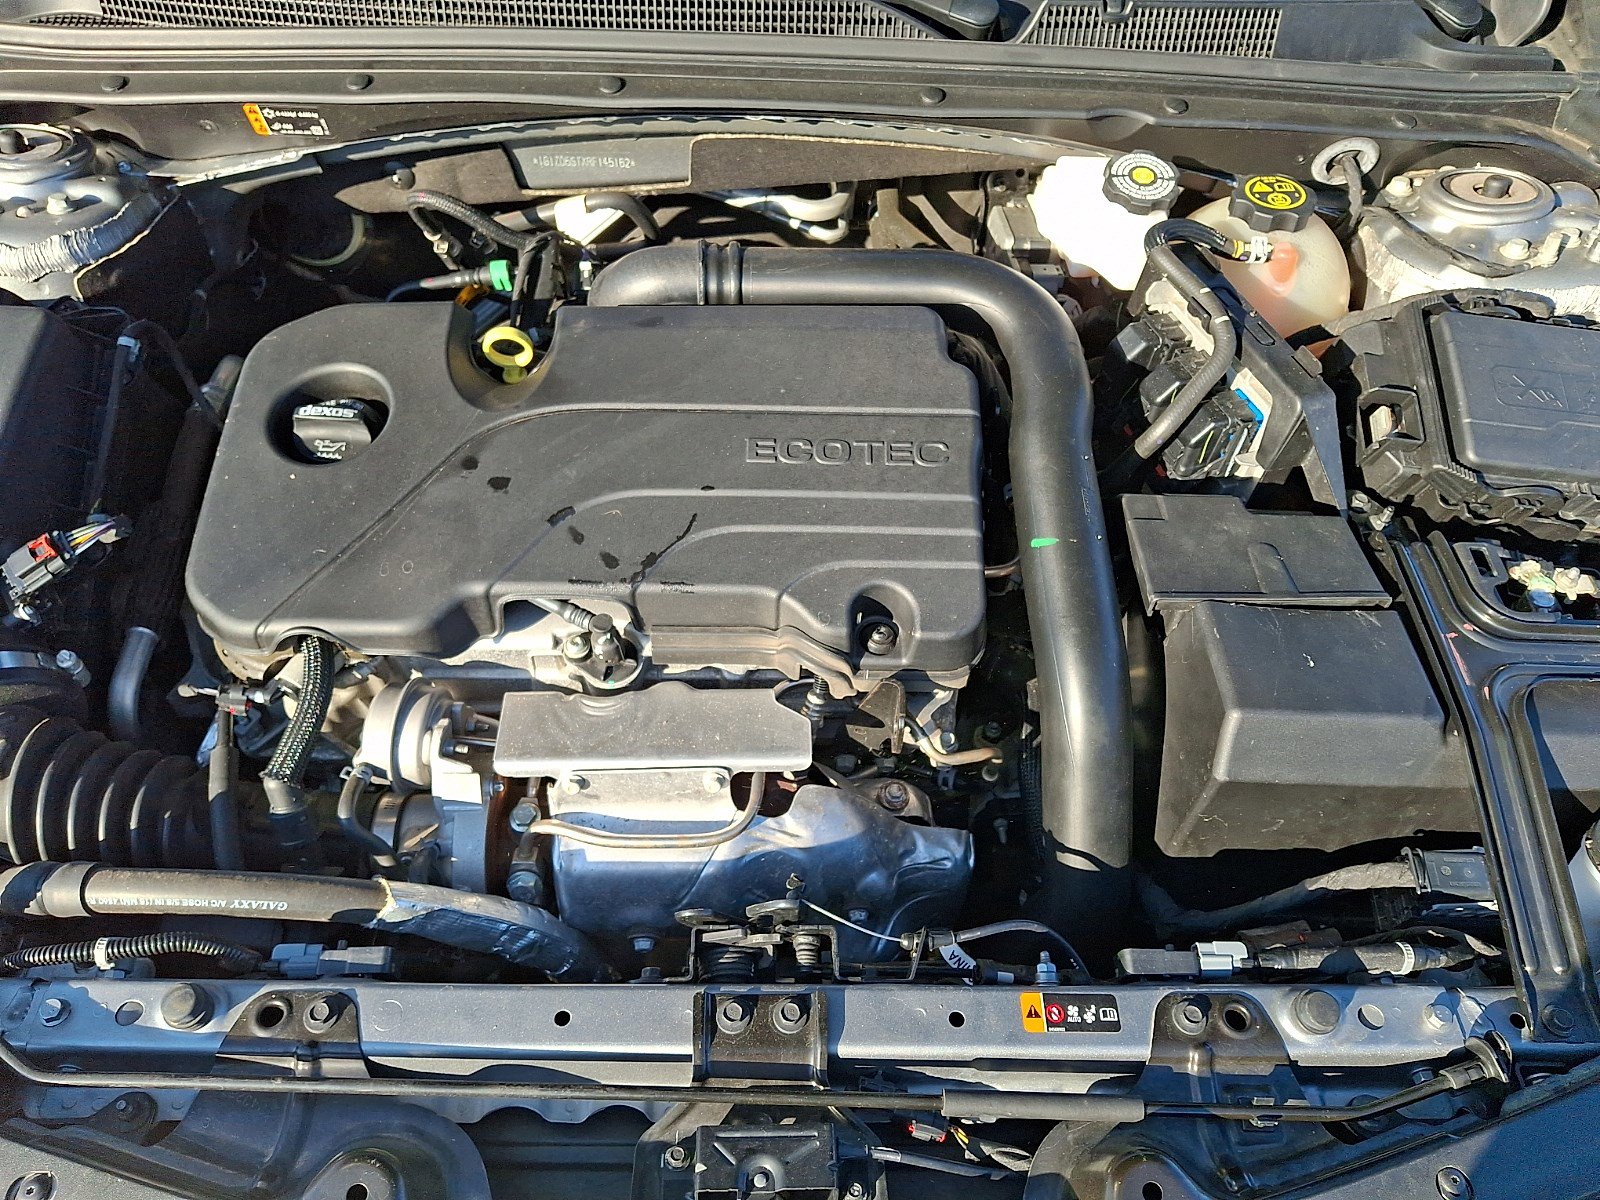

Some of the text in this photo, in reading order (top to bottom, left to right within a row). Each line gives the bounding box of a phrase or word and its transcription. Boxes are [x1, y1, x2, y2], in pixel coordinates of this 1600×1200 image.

[298, 404, 357, 418] dexos
[744, 437, 950, 467] ECOTEC
[182, 898, 209, 907] HOSE
[210, 899, 227, 908] A/C
[230, 899, 288, 911] GALAXY
